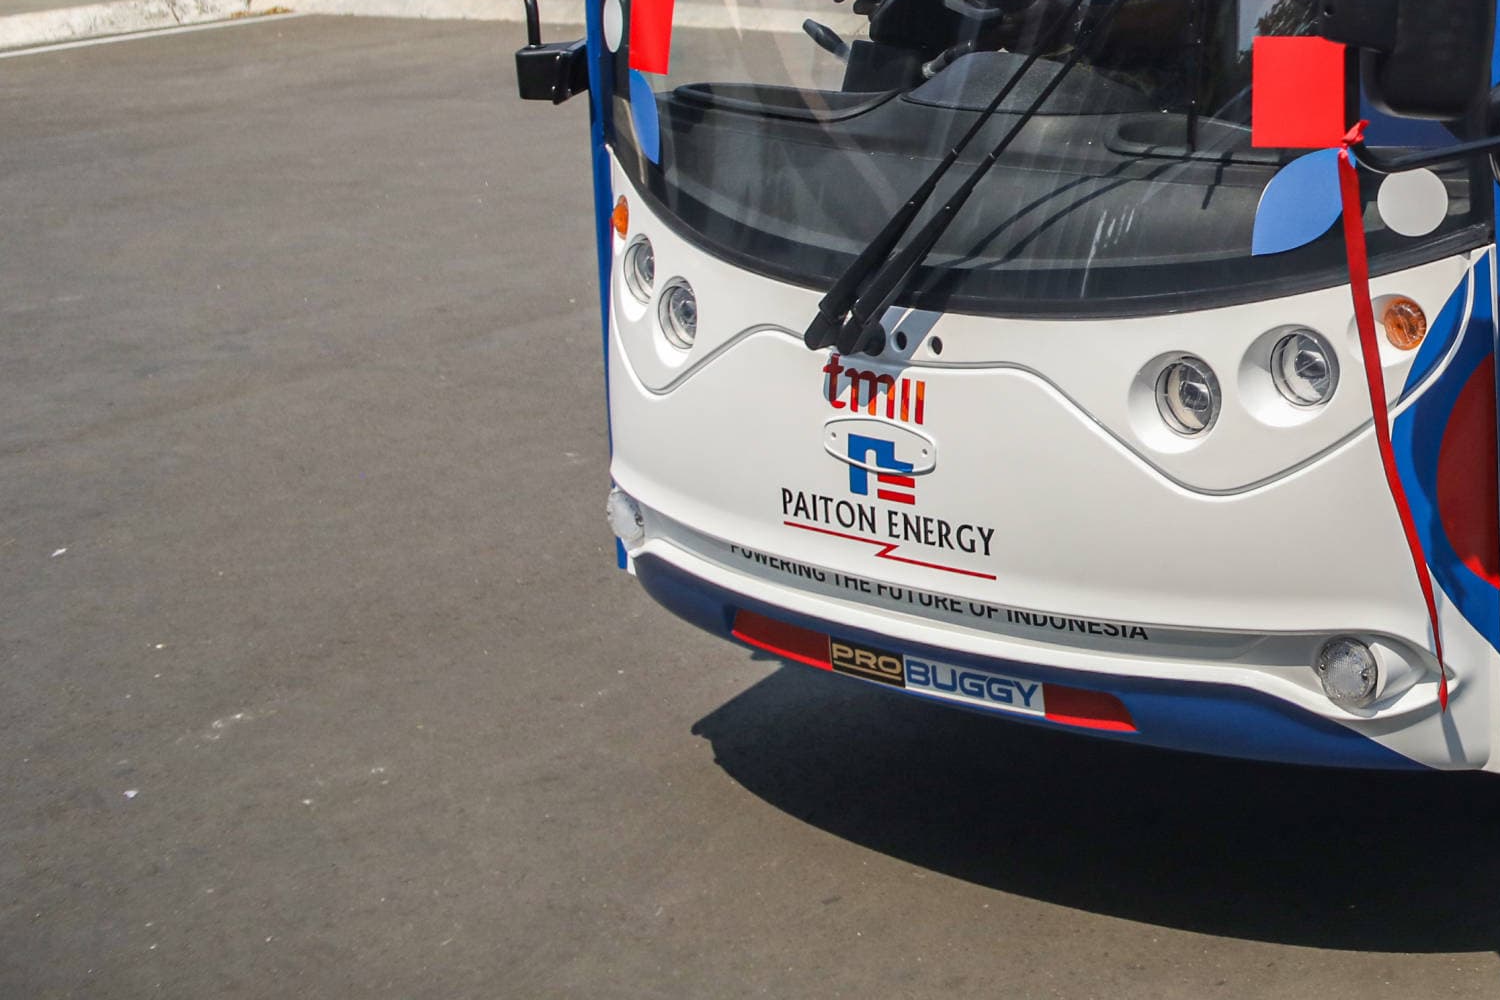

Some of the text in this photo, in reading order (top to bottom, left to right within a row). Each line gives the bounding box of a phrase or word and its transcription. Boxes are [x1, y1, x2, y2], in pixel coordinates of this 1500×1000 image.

[781, 487, 995, 556] PAITON ENERGY
[1007, 609, 1149, 640] INDONESIA
[832, 642, 1040, 708] PRO BUGGY
